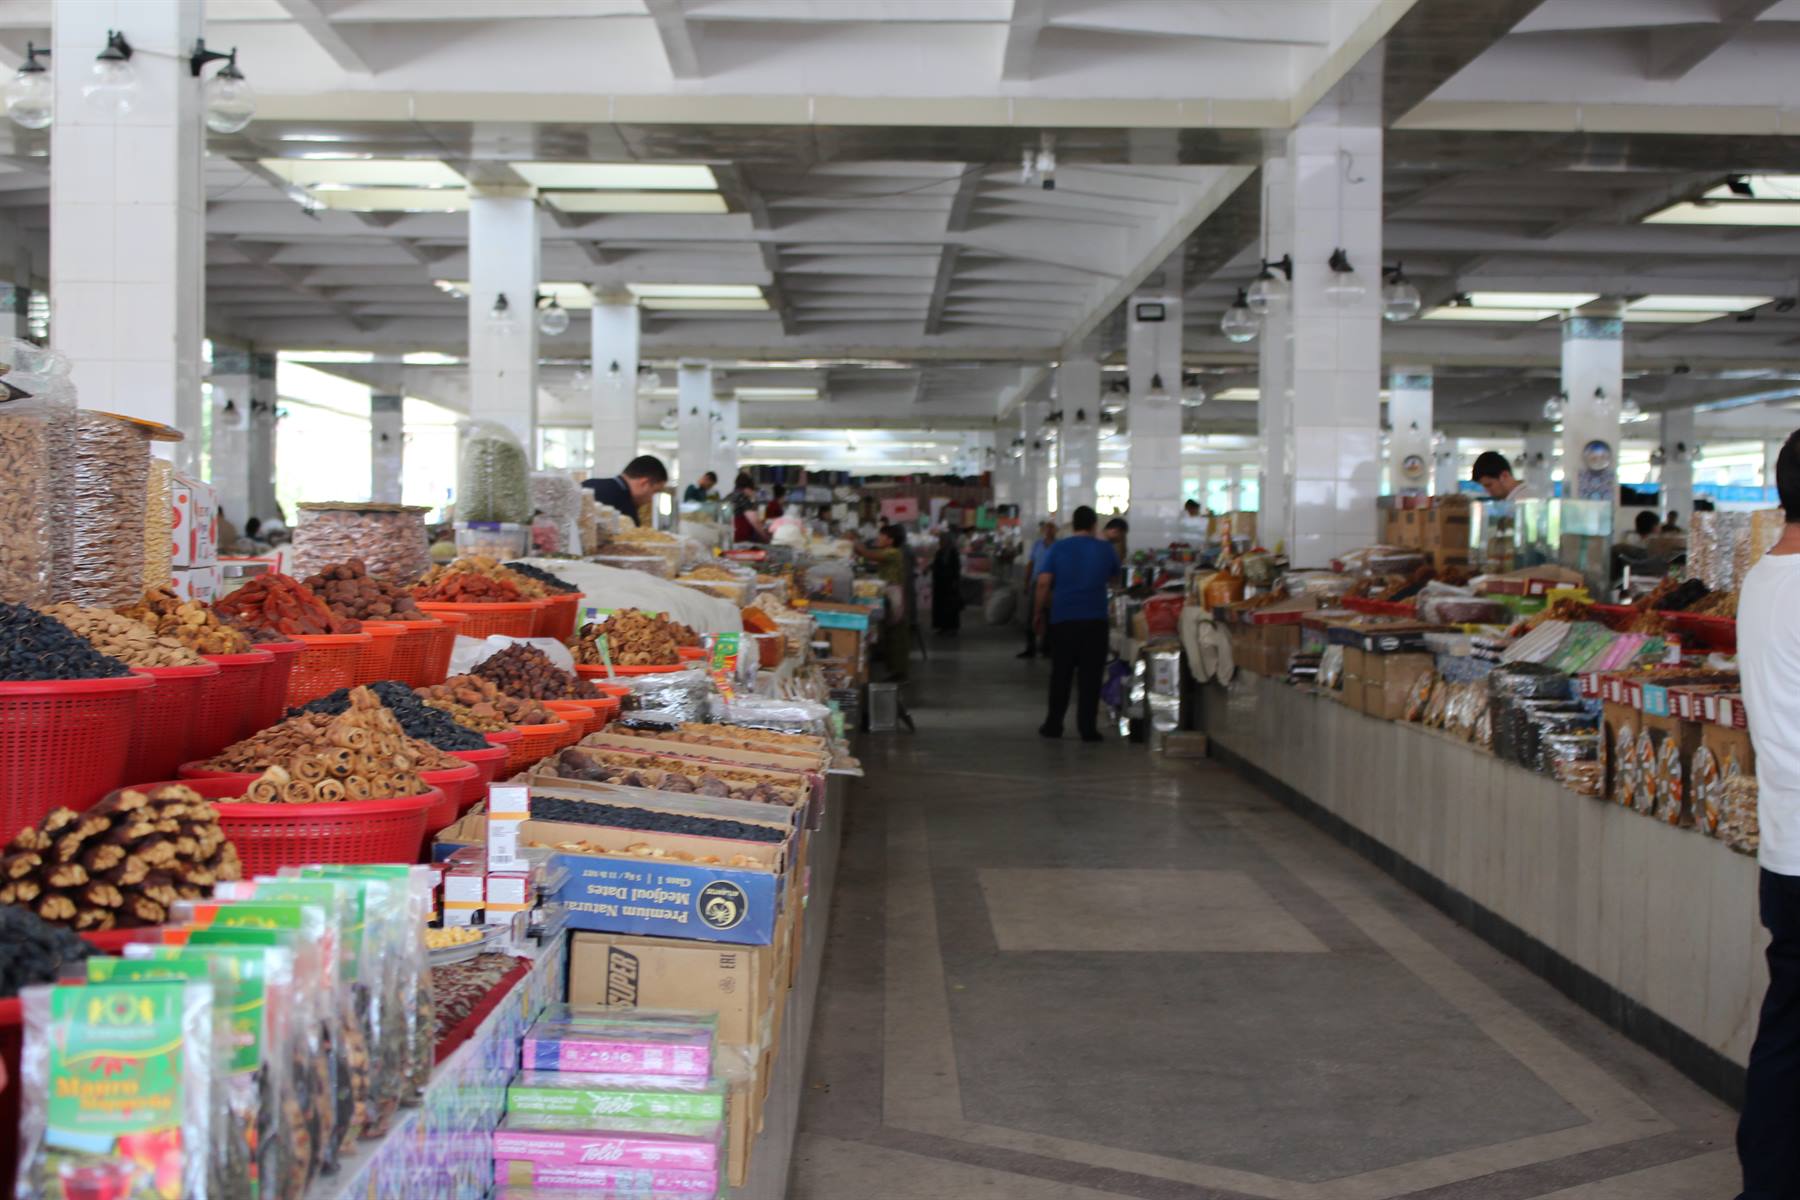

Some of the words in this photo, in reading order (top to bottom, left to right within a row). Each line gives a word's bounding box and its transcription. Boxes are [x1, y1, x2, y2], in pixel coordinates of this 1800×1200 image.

[587, 885, 627, 899] Dates
[632, 888, 690, 905] Medjoul
[623, 907, 688, 924] Premium
[610, 953, 637, 1007] SUPER
